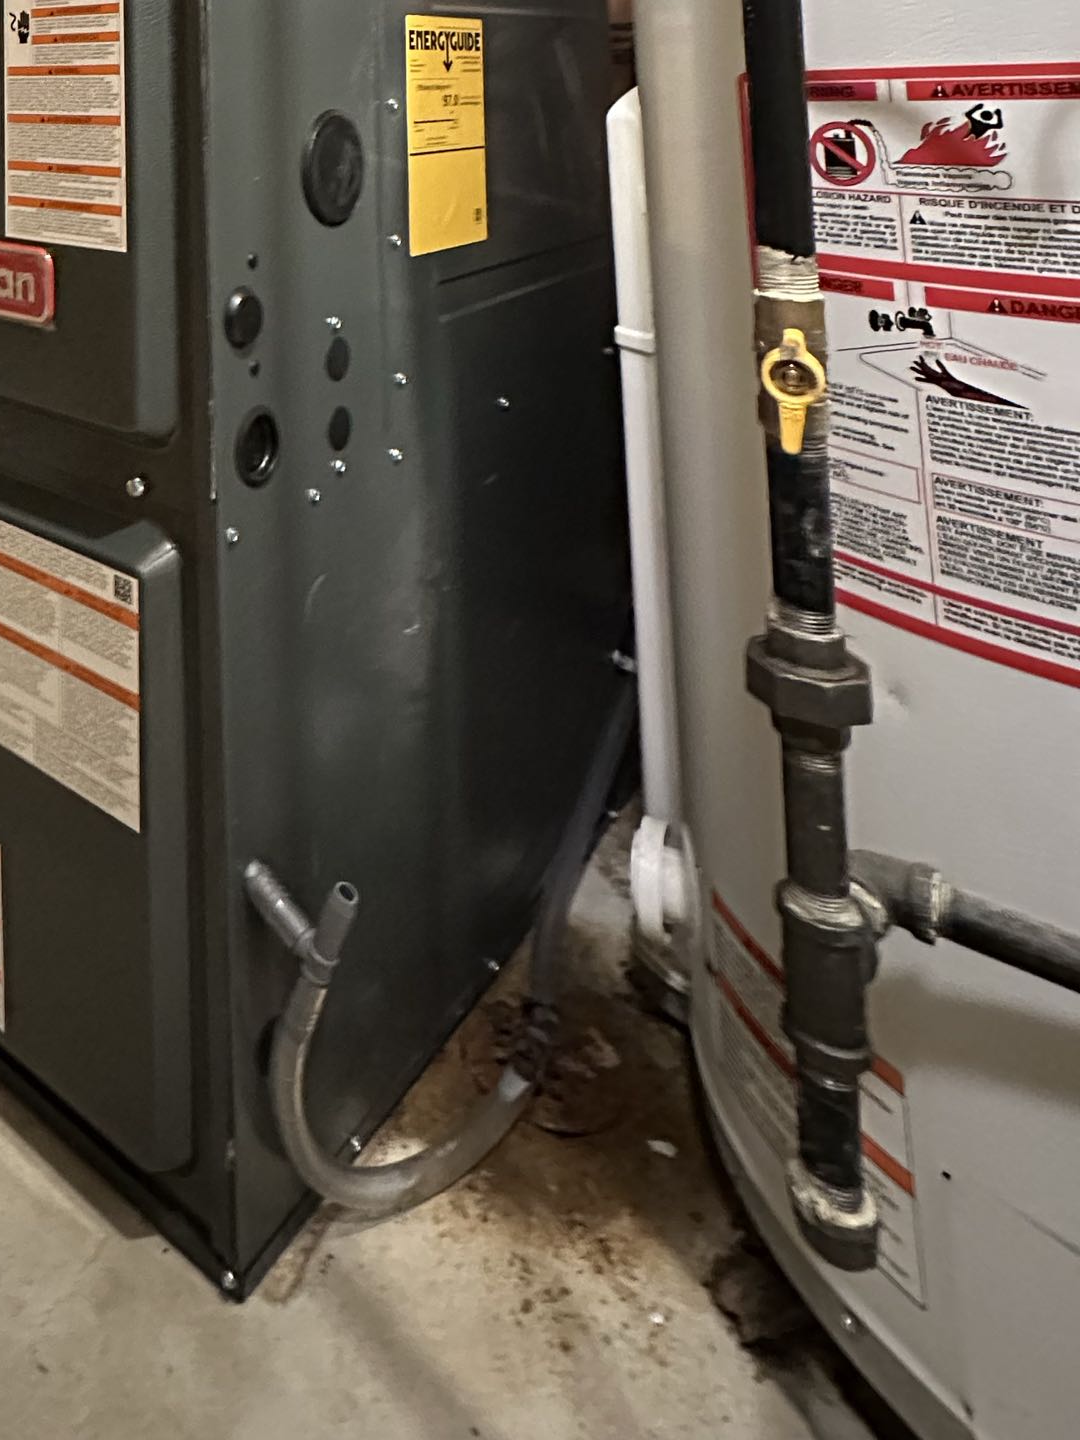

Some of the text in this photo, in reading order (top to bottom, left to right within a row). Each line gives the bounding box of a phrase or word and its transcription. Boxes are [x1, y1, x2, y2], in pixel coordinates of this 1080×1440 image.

[408, 29, 481, 52] ENERGYGUIDE
[848, 193, 892, 204] HAZARD
[919, 197, 965, 209] RISQUE
[968, 200, 1046, 213] D'INCENDIE
[1049, 204, 1066, 214] ET
[1010, 300, 1080, 320] DANG
[944, 352, 967, 364] EAU
